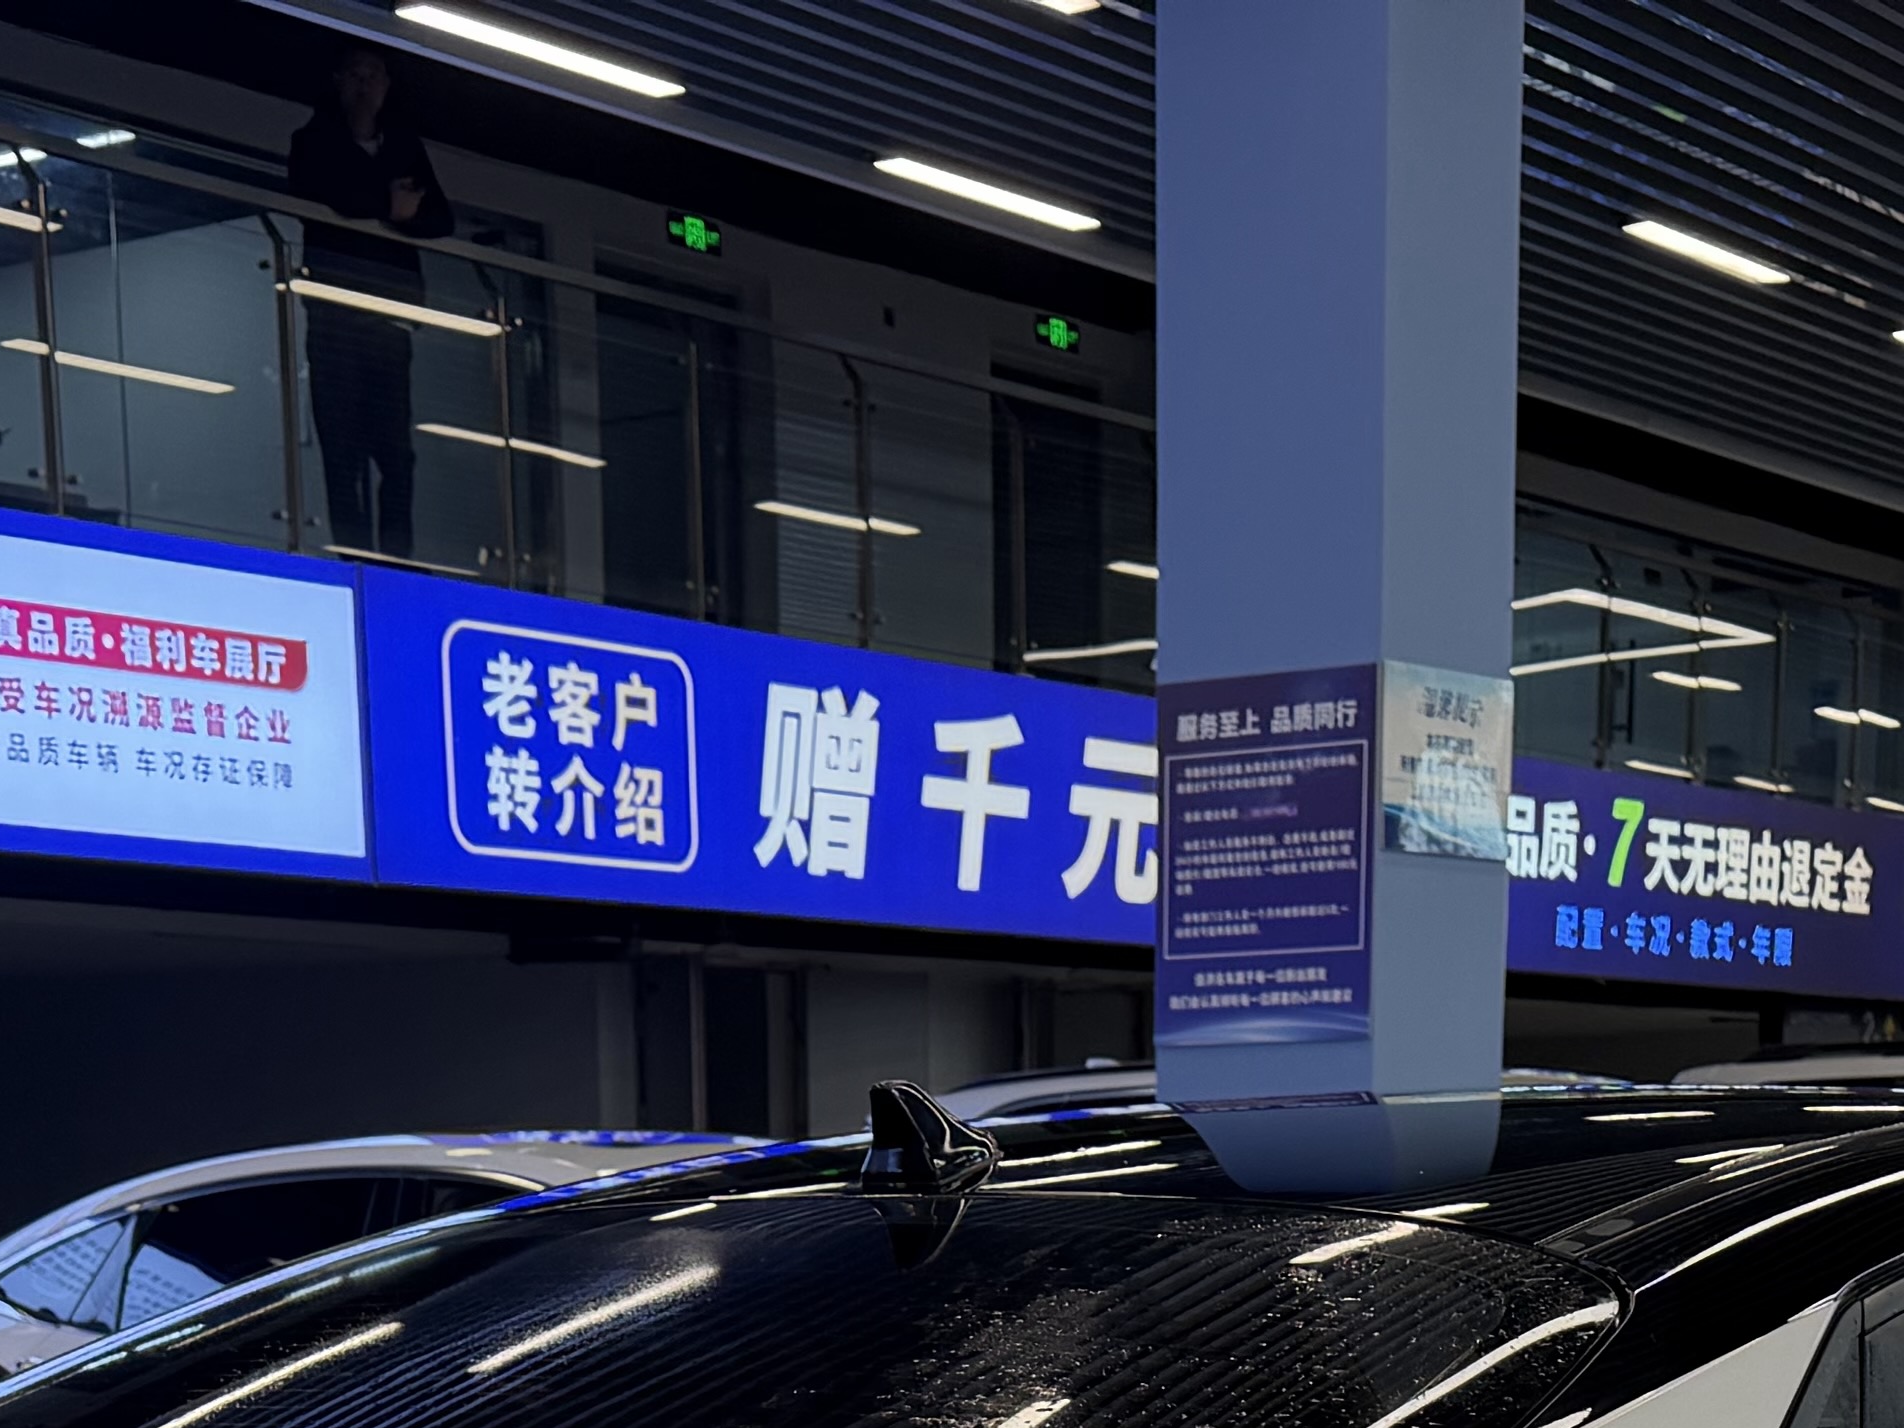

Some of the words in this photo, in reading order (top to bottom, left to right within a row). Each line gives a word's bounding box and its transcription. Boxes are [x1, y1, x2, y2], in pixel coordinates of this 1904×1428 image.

[481, 650, 658, 750] 老客户
[1176, 707, 1261, 742] 服务至上
[1270, 699, 1358, 734] 品质同行
[135, 747, 293, 788] 车况存证保障
[484, 745, 667, 845] 转介绍
[754, 681, 1158, 905] 赠千元
